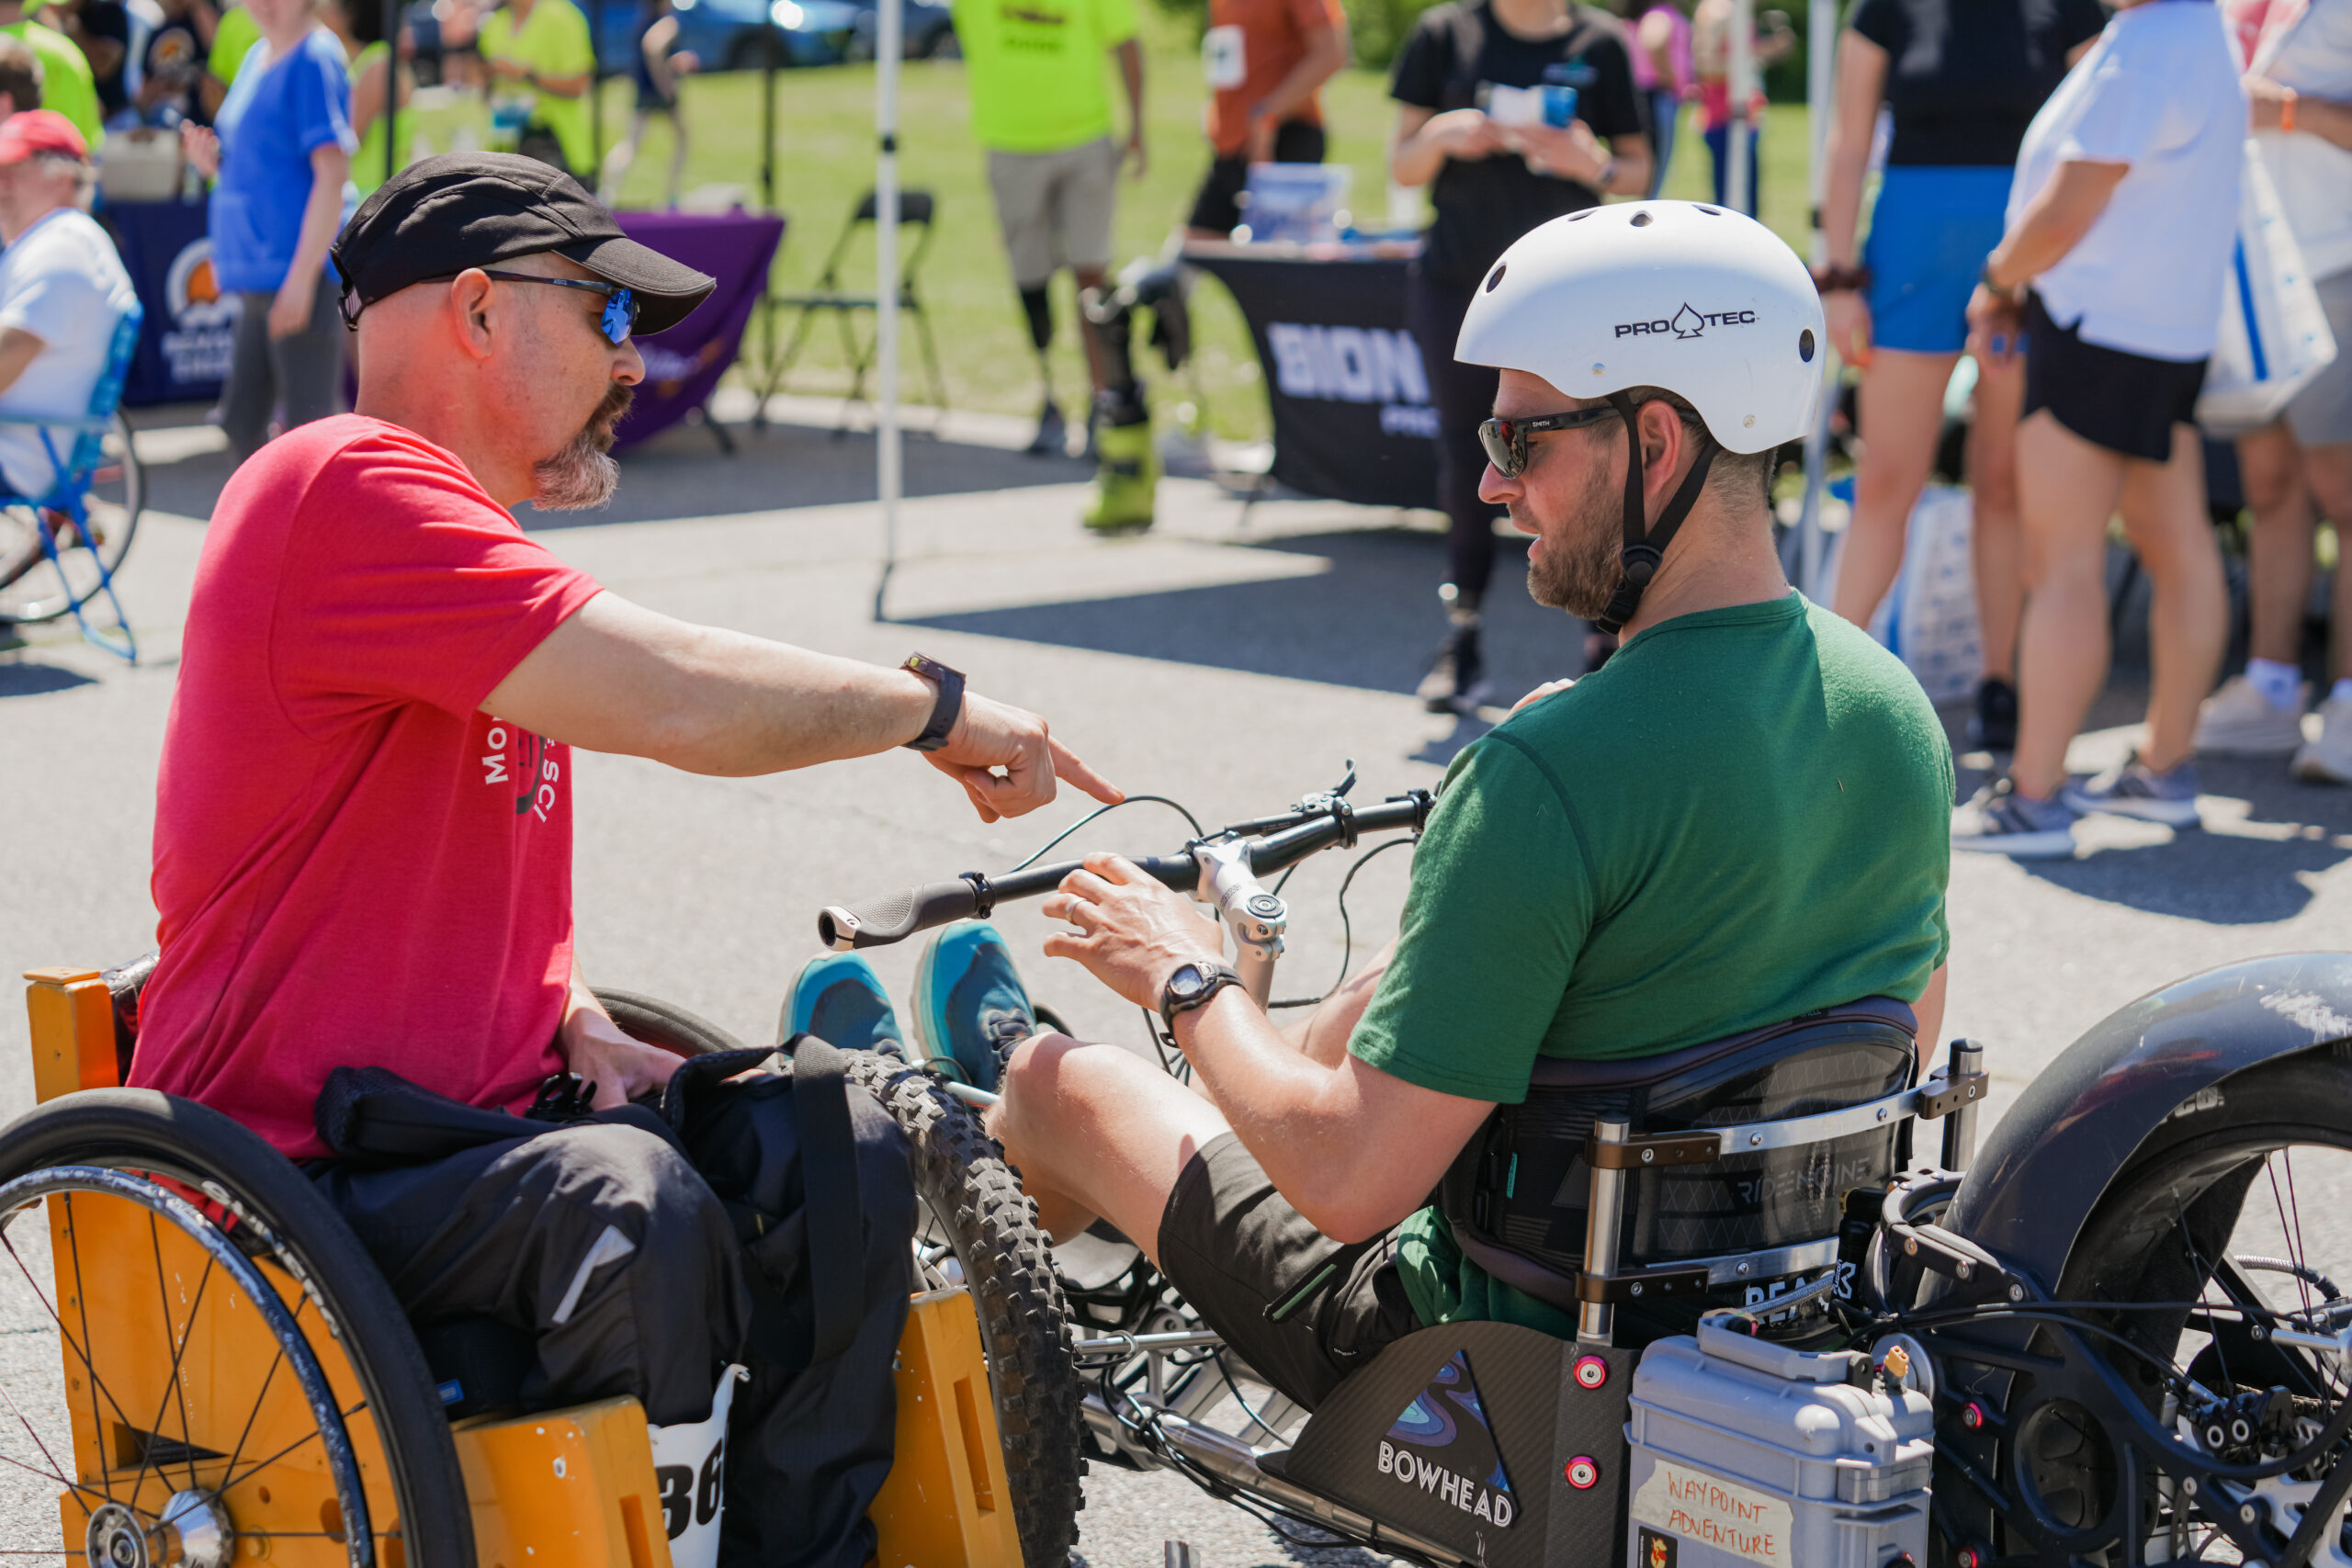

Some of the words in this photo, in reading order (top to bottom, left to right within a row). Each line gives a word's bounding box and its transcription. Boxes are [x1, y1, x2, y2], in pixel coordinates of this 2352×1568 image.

[1614, 319, 1671, 339] PRO
[1702, 310, 1756, 328] TEC
[1532, 419, 1551, 428] SMITH
[1378, 1440, 1512, 1528] BOWHEAD
[1668, 1471, 1768, 1524] WAYPOINT
[1668, 1508, 1776, 1556] ADVENTURE
